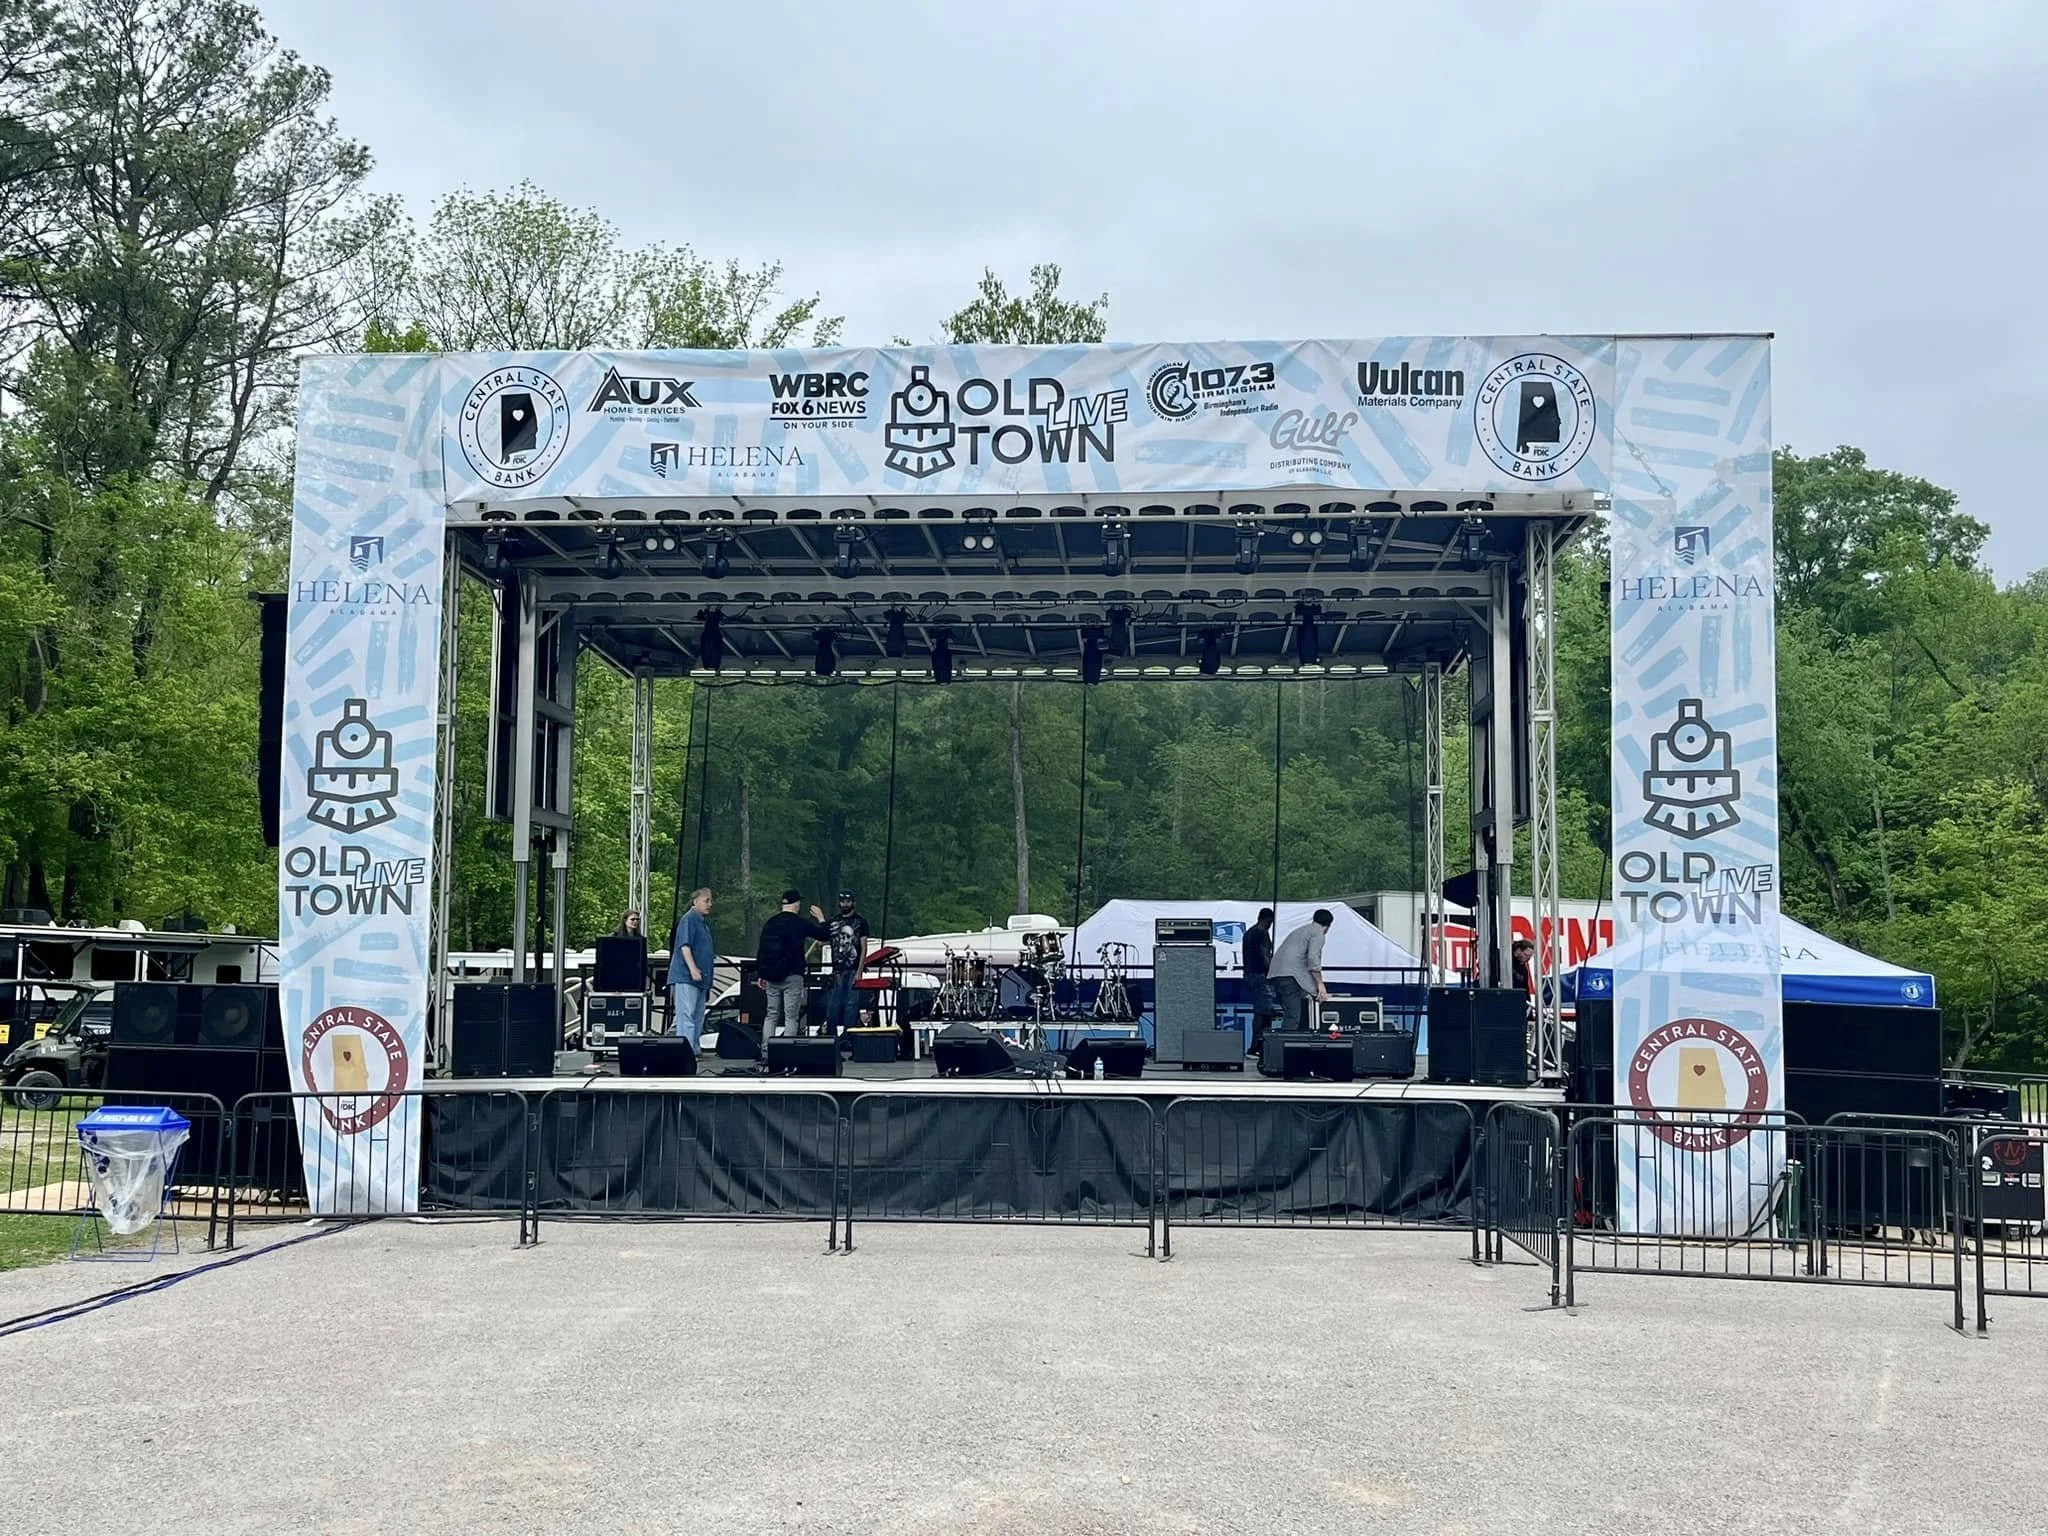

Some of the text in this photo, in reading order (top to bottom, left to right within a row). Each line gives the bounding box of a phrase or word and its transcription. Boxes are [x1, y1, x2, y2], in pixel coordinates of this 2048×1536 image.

[588, 369, 700, 412] AUX
[768, 371, 870, 398] WBRC
[1189, 362, 1275, 392] 107.3
[1192, 383, 1276, 399] BIRMINGHAM
[1357, 361, 1464, 396] Vulcan
[1481, 359, 1591, 407] CENTRAL STATE
[465, 371, 565, 421] CENTRAL STATE
[603, 406, 686, 415] HOME SERVICES
[771, 400, 867, 416] FOX 6 NEWS
[956, 377, 1065, 416] OLD
[1046, 388, 1129, 433] LIVE
[1219, 403, 1279, 417] Independent Radio
[1357, 396, 1463, 410] Materials Company
[783, 420, 855, 430] ON YOUR SIDE
[957, 409, 1115, 465] TOWN
[1269, 408, 1359, 457] Gulf
[687, 446, 805, 467] HELENA
[1269, 457, 1352, 470] DISTRIBUTING COMPANY
[1512, 461, 1558, 476] BANK
[494, 467, 536, 484] BANK
[296, 580, 433, 605] HELENA
[1620, 574, 1766, 601] HELENA
[329, 608, 397, 616] ALABAMA
[1657, 603, 1729, 612] ALABAMA
[284, 845, 371, 878] OLD
[354, 857, 426, 891] LIVE
[1618, 850, 1716, 884] OLD
[1699, 863, 1773, 899] LIVE
[285, 883, 413, 917] TOWN
[1619, 890, 1762, 925] TOWN
[304, 1011, 403, 1060] ENTRAL STATE
[1635, 1023, 1761, 1077] CENTRAL STATE
[1673, 1130, 1727, 1148] BANK
